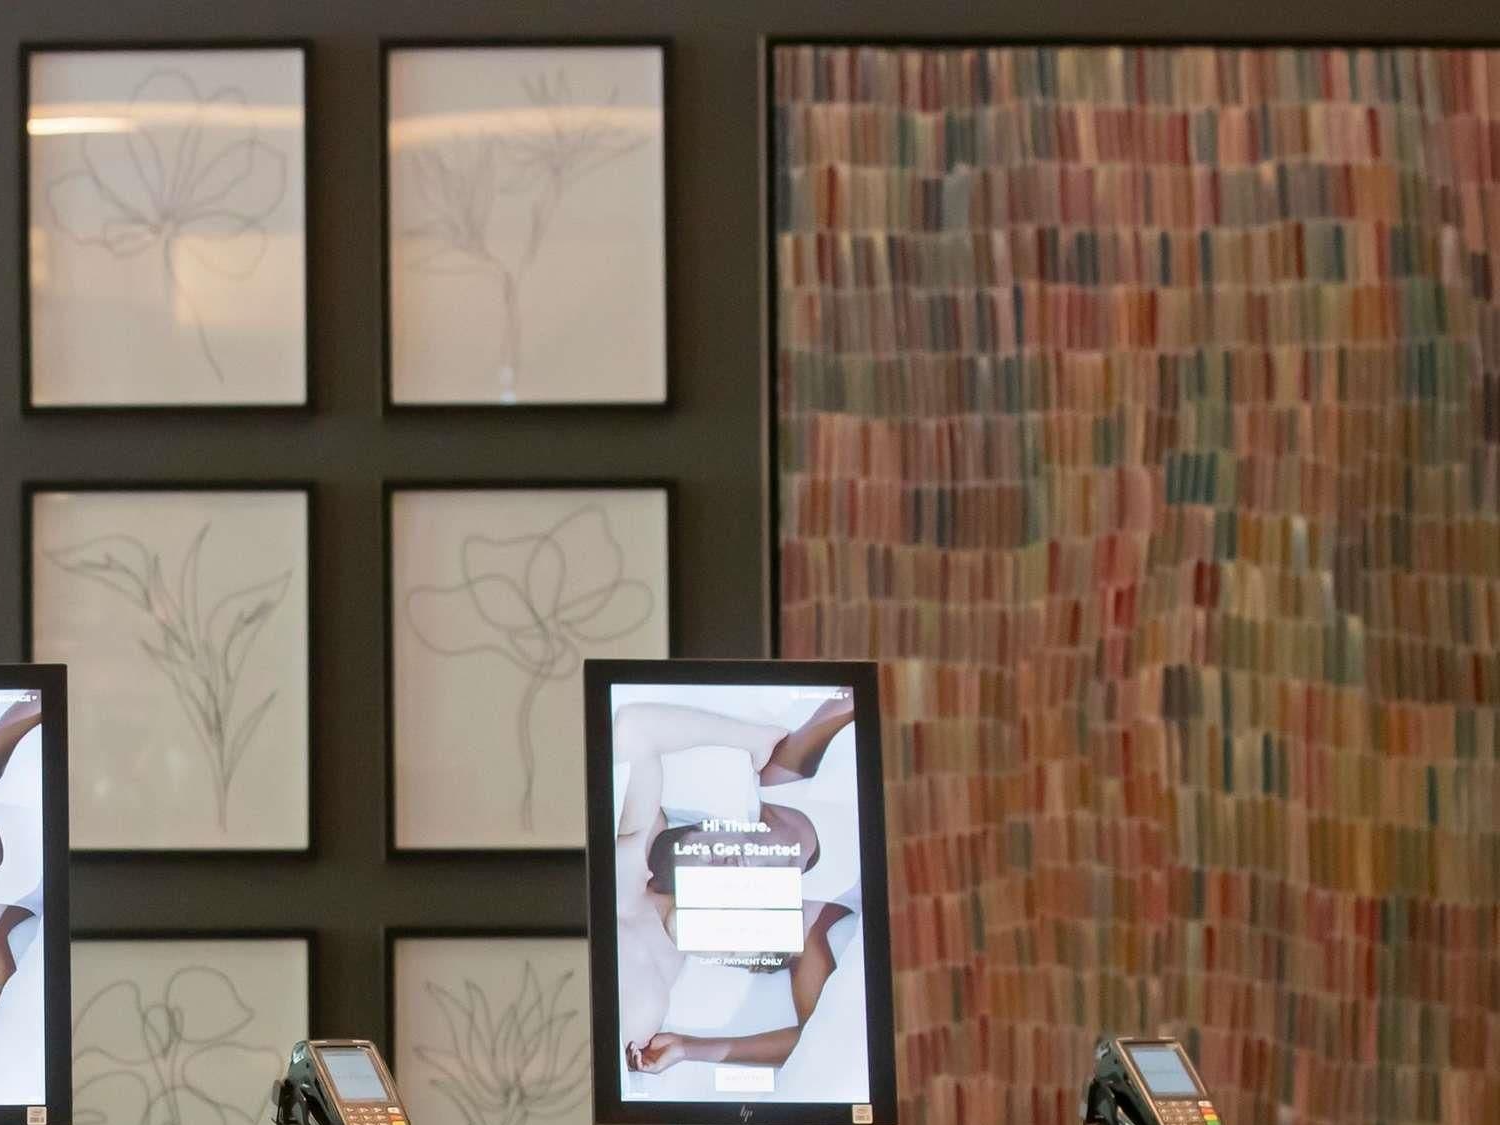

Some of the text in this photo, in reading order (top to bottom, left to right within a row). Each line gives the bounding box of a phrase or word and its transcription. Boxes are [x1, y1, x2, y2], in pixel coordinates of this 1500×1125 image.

[703, 819, 770, 832] Hi There.
[674, 842, 801, 856] Let's Get Started
[723, 958, 760, 966] PAYMENT
[761, 958, 783, 966] ONLY
